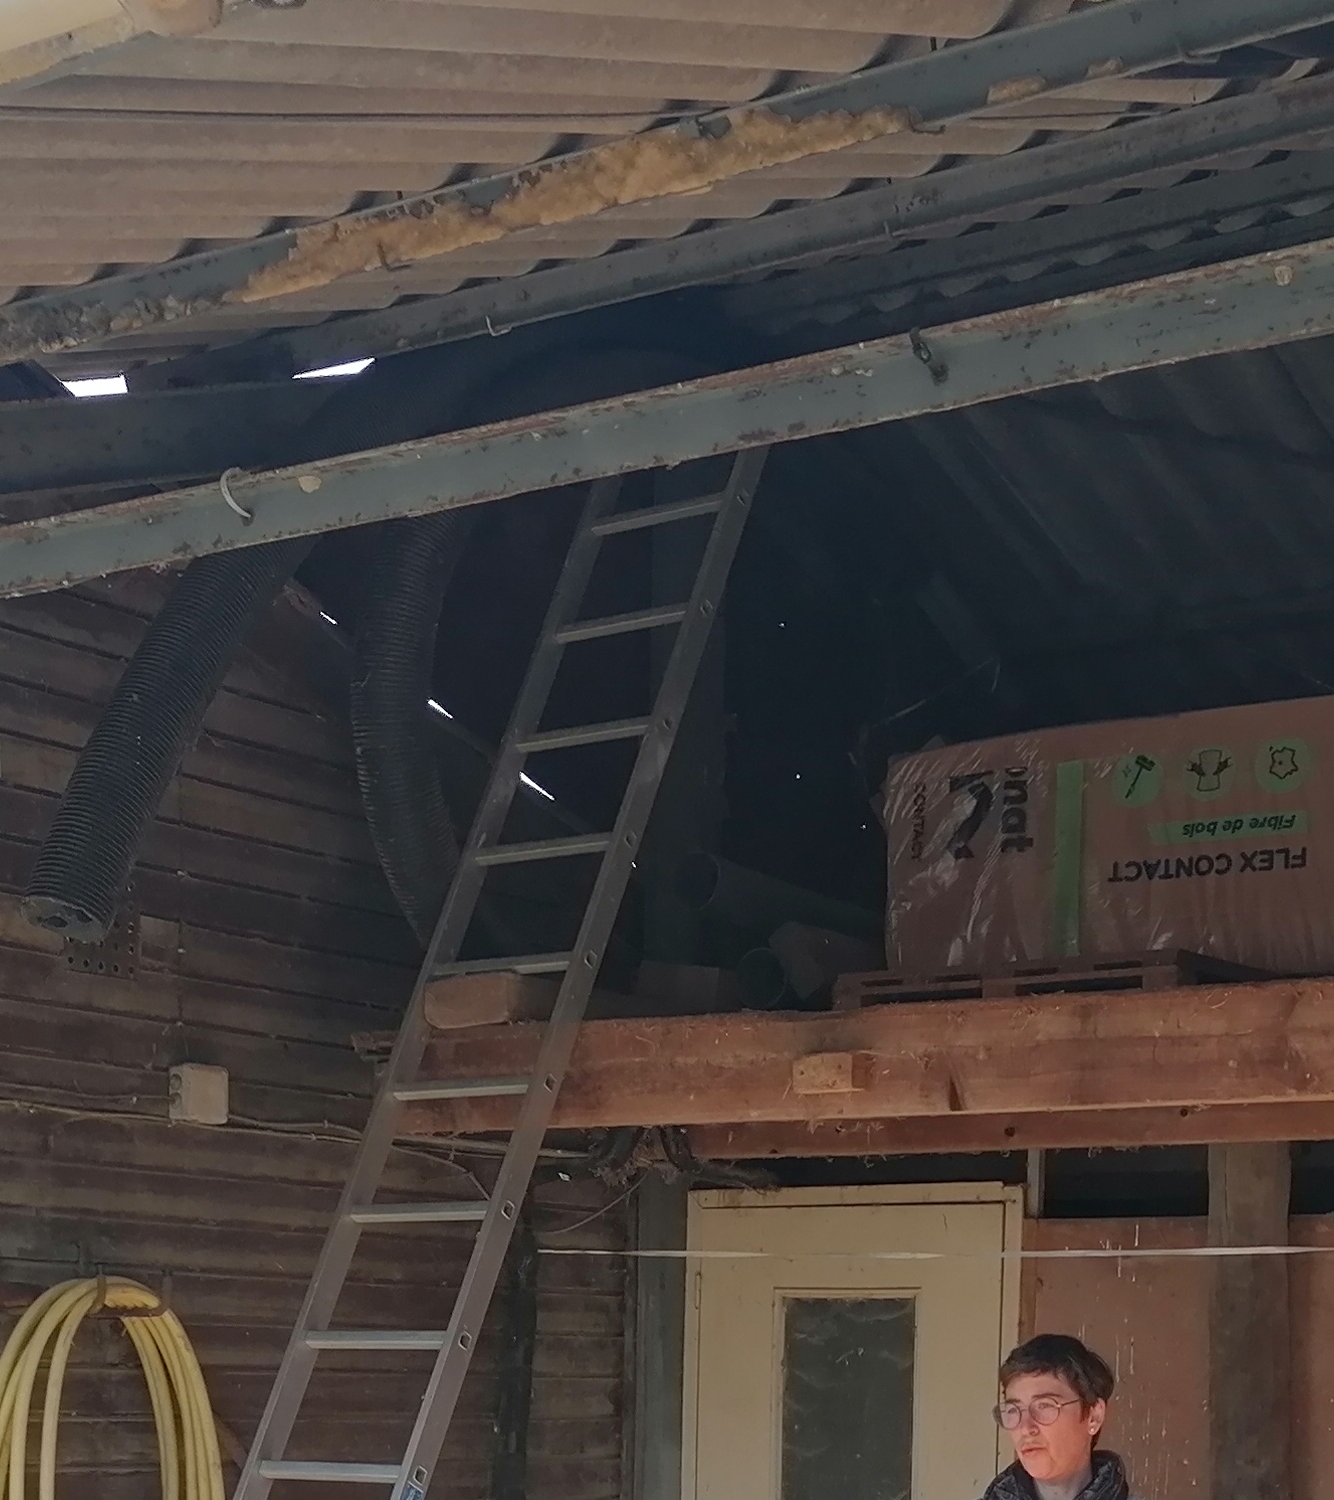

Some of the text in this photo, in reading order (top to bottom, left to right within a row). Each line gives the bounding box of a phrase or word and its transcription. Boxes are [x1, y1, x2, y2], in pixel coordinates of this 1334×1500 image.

[1182, 814, 1296, 838] Fibre de bois
[1107, 847, 1308, 883] FLEX CONTACT
